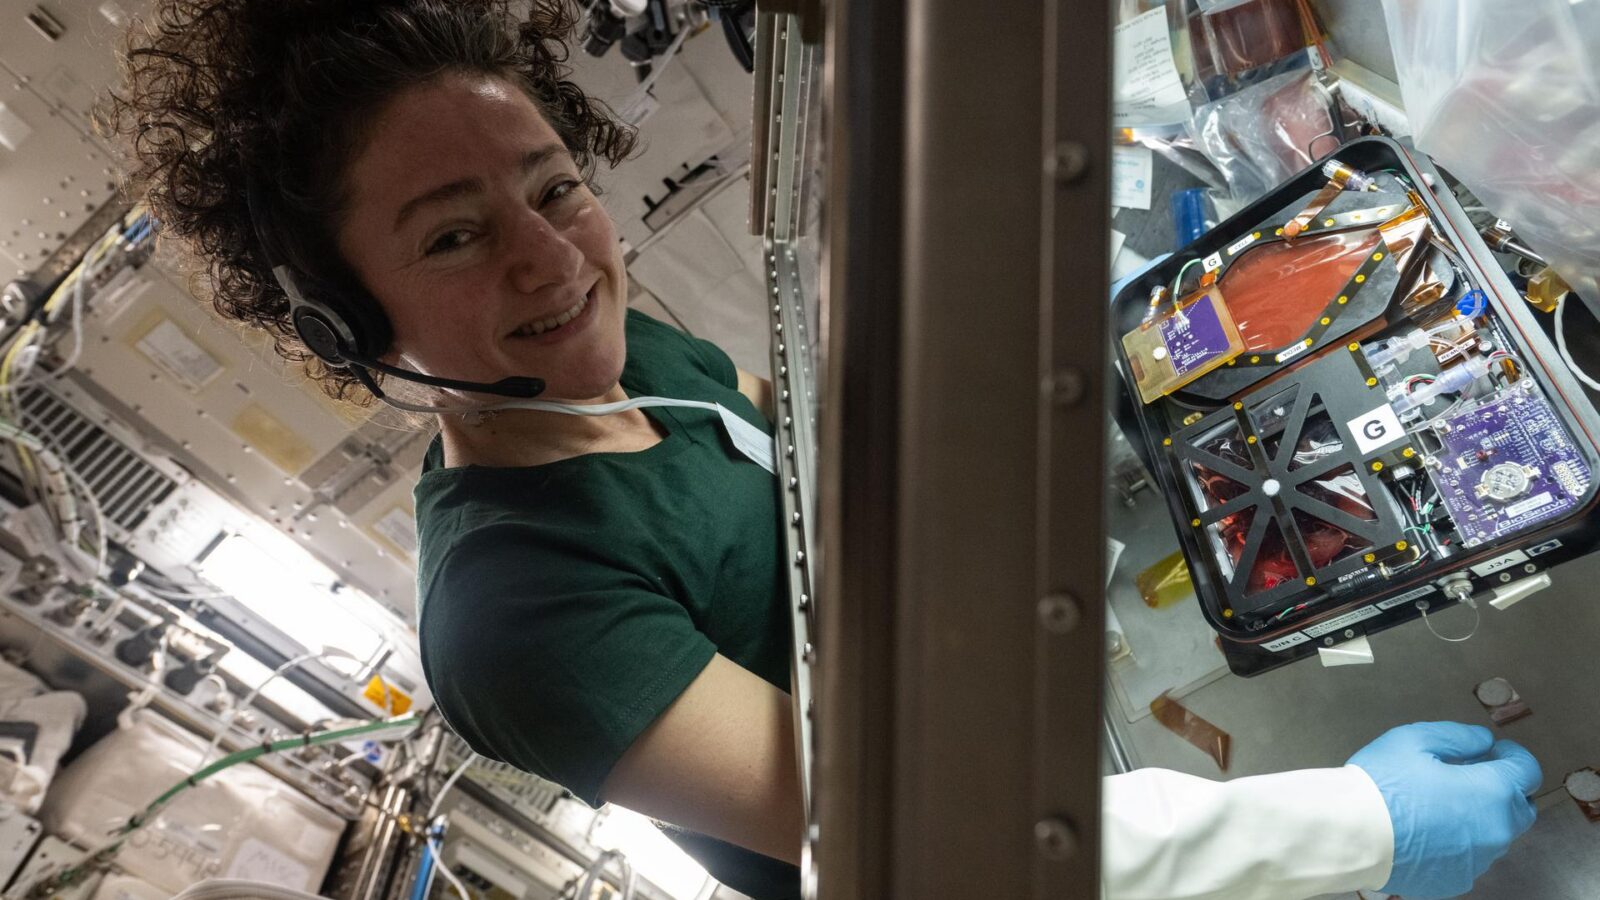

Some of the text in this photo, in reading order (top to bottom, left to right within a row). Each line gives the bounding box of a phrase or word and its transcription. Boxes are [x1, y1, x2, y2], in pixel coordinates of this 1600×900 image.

[1208, 258, 1217, 267] G
[1363, 419, 1387, 440] G
[1270, 640, 1290, 649] S/N
